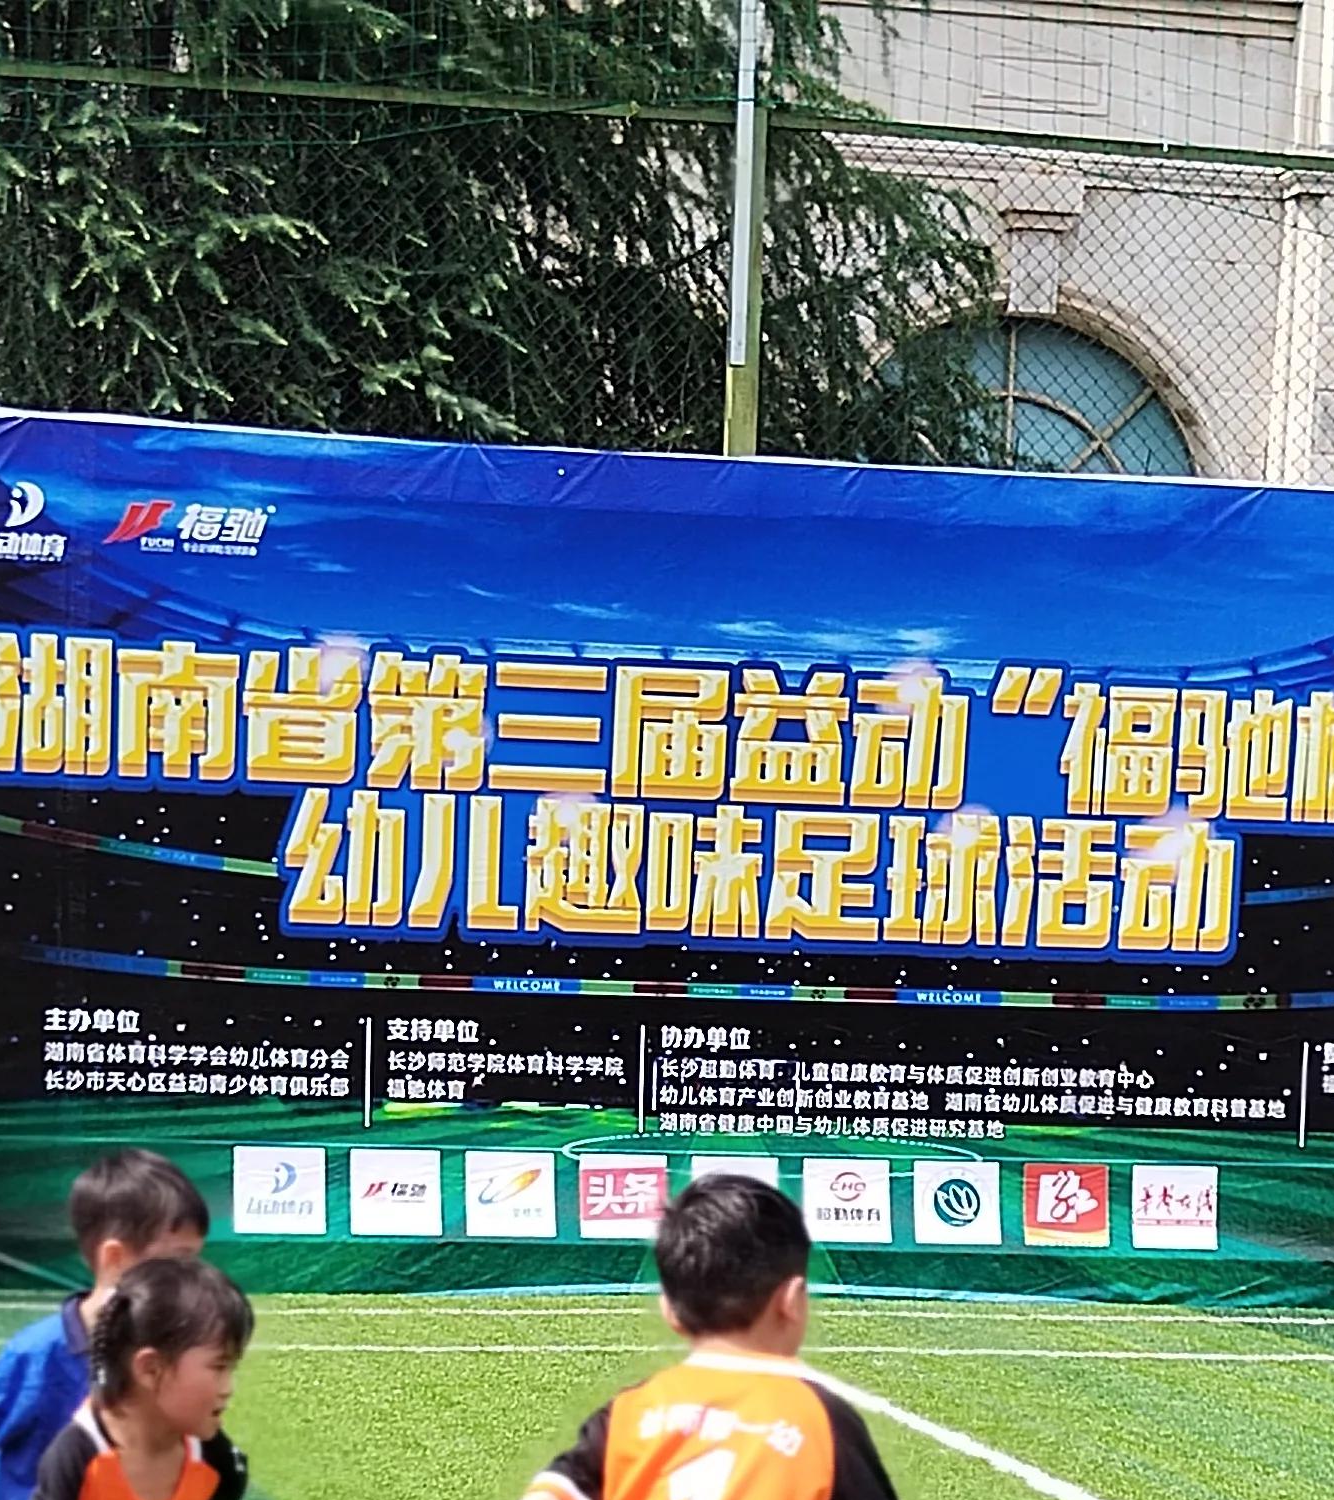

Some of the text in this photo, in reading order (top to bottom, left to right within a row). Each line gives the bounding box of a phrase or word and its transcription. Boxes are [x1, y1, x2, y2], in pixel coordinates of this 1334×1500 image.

[177, 503, 269, 543] 福驰
[285, 788, 1236, 952] 幼儿趣味足球活动
[492, 978, 561, 993] WELCOME
[916, 991, 982, 1005] WELCOME
[43, 1008, 140, 1033] 主办单位
[386, 1017, 480, 1043] 支持单位
[661, 1025, 751, 1050] 协办单位
[44, 1041, 350, 1070] 湖南省体育科学学会幼儿体育分会
[387, 1050, 624, 1076] 长沙师范学院体育科学学院
[44, 1069, 350, 1097] 长沙市天心区益动青少体育俱乐部
[387, 1078, 466, 1099] 福驰体育
[660, 1085, 929, 1112] 幼儿体育产业创新创业教育基地
[660, 1112, 1005, 1139] 湖南省健康中国与幼儿体质促进研究基地
[586, 1171, 660, 1217] 头条
